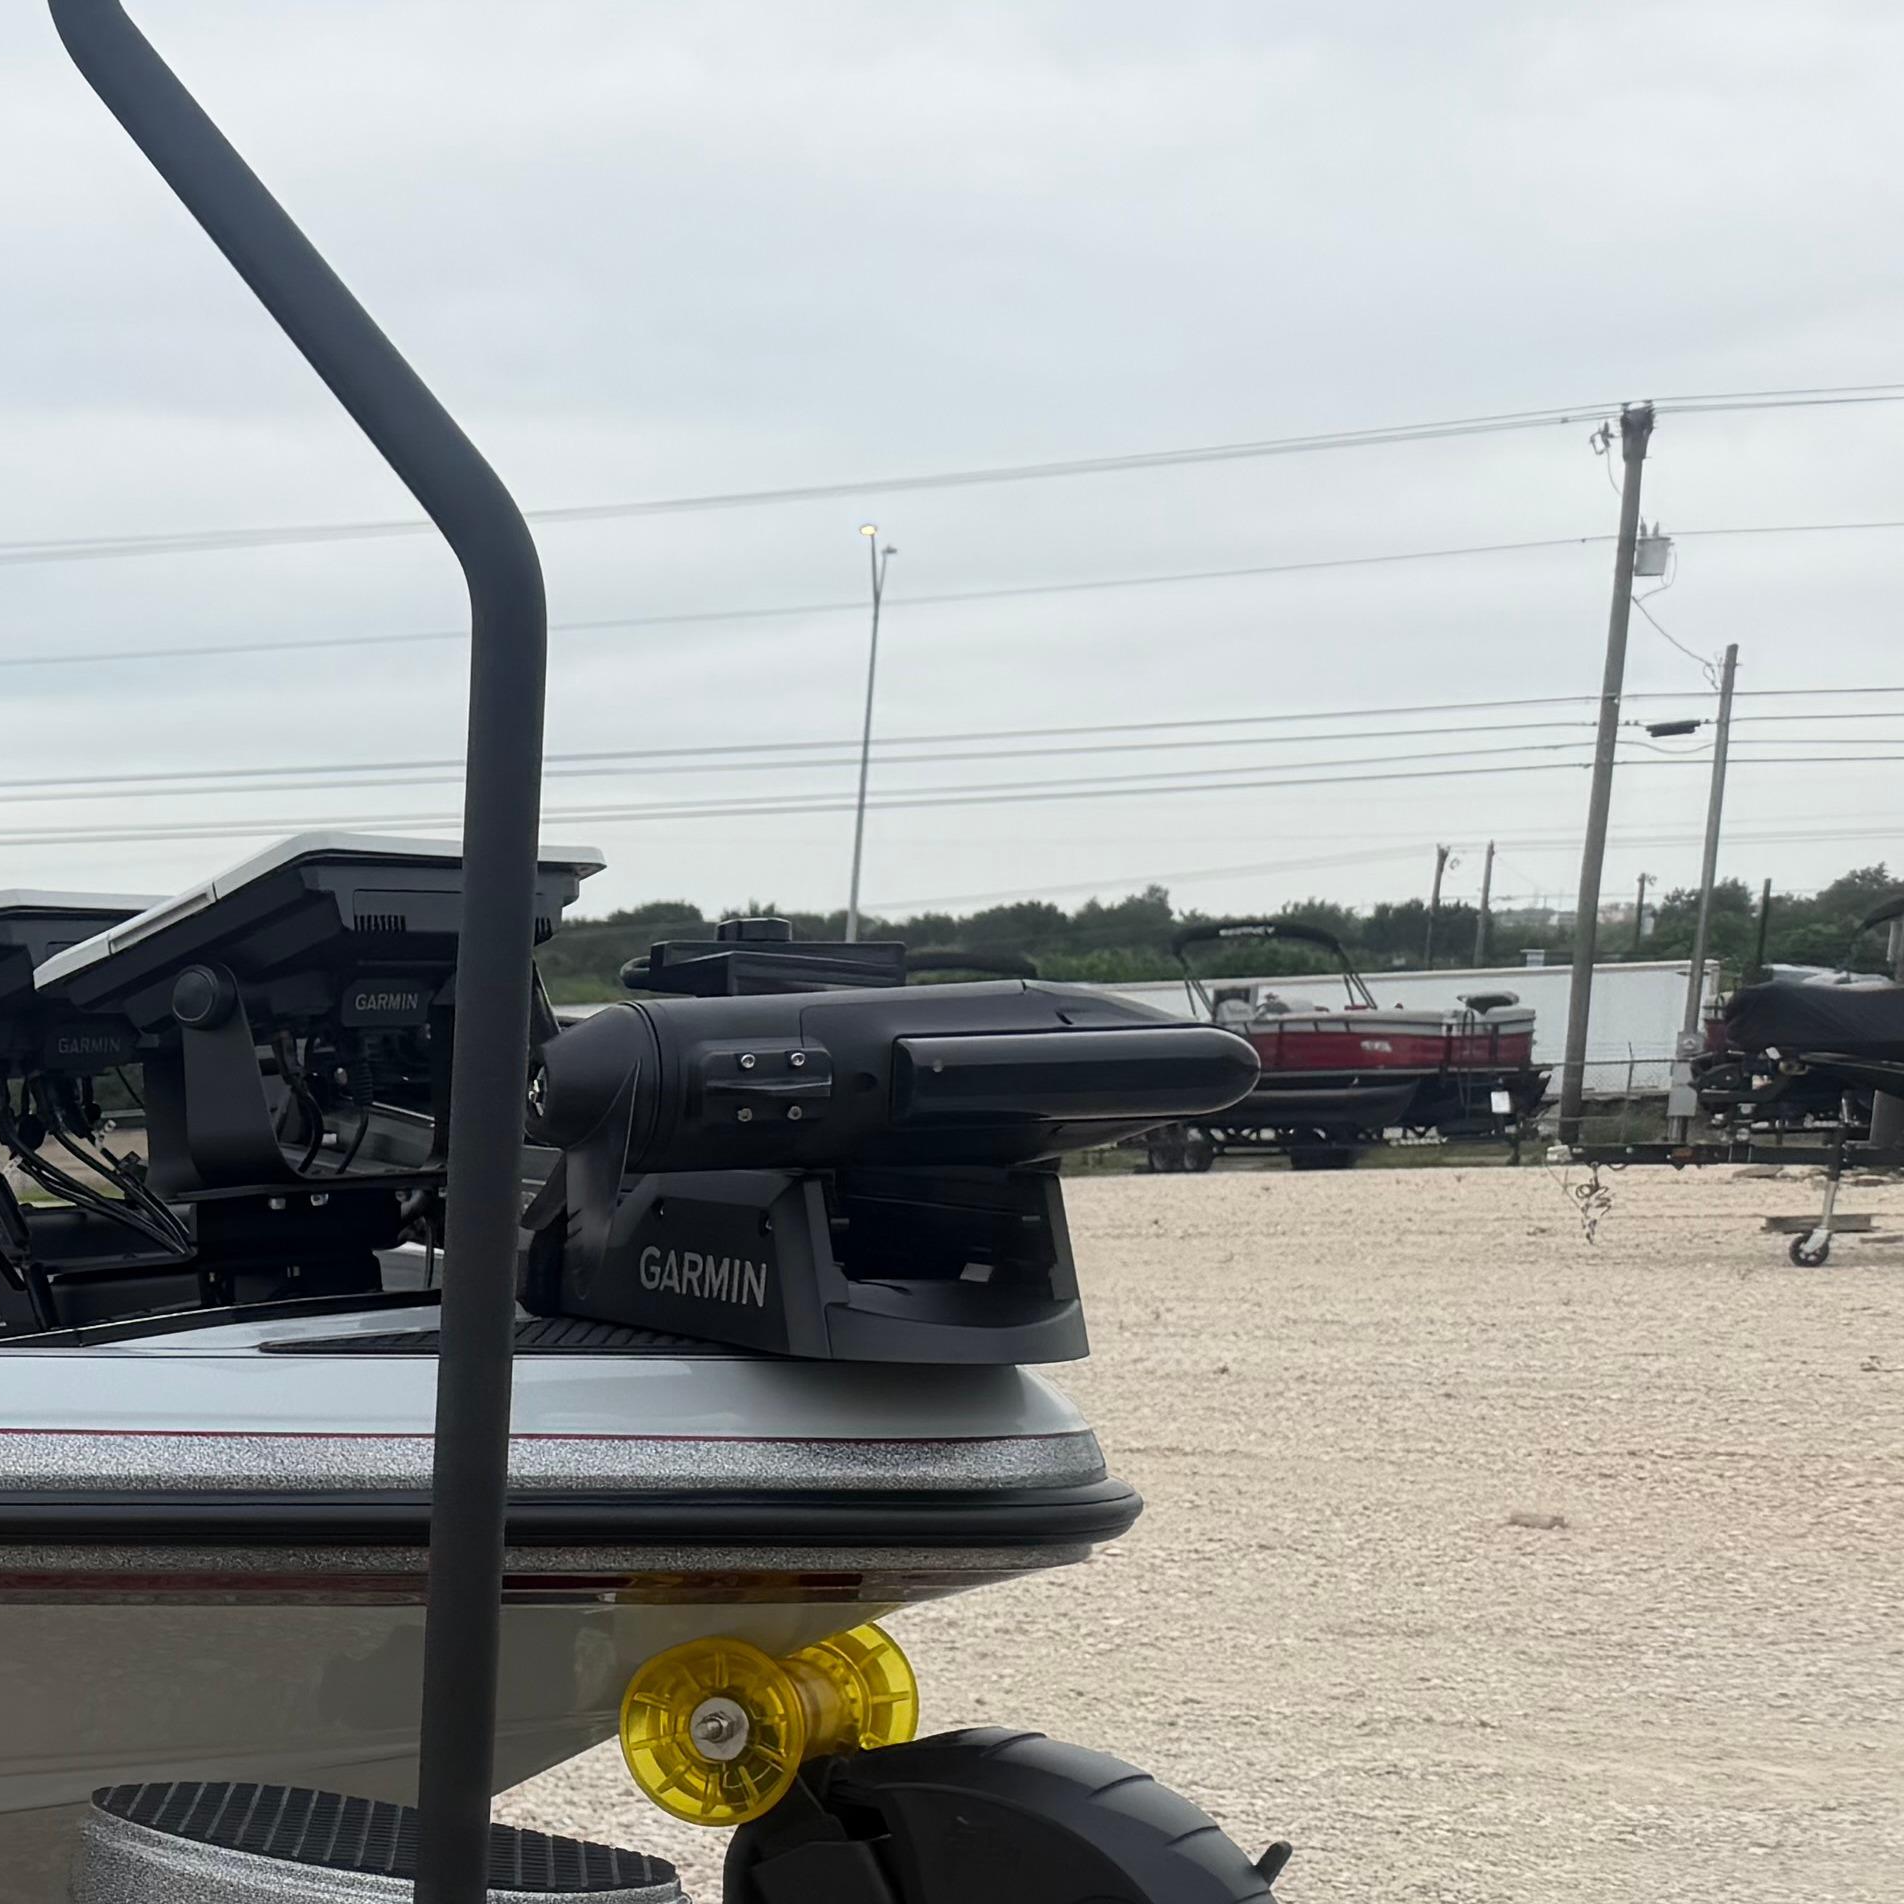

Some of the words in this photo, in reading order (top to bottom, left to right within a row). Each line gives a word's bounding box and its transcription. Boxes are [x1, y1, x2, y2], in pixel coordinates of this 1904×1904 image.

[355, 993, 418, 1011] GARMIN
[58, 1036, 121, 1055] GARMIN
[639, 1246, 768, 1308] GARMIN
